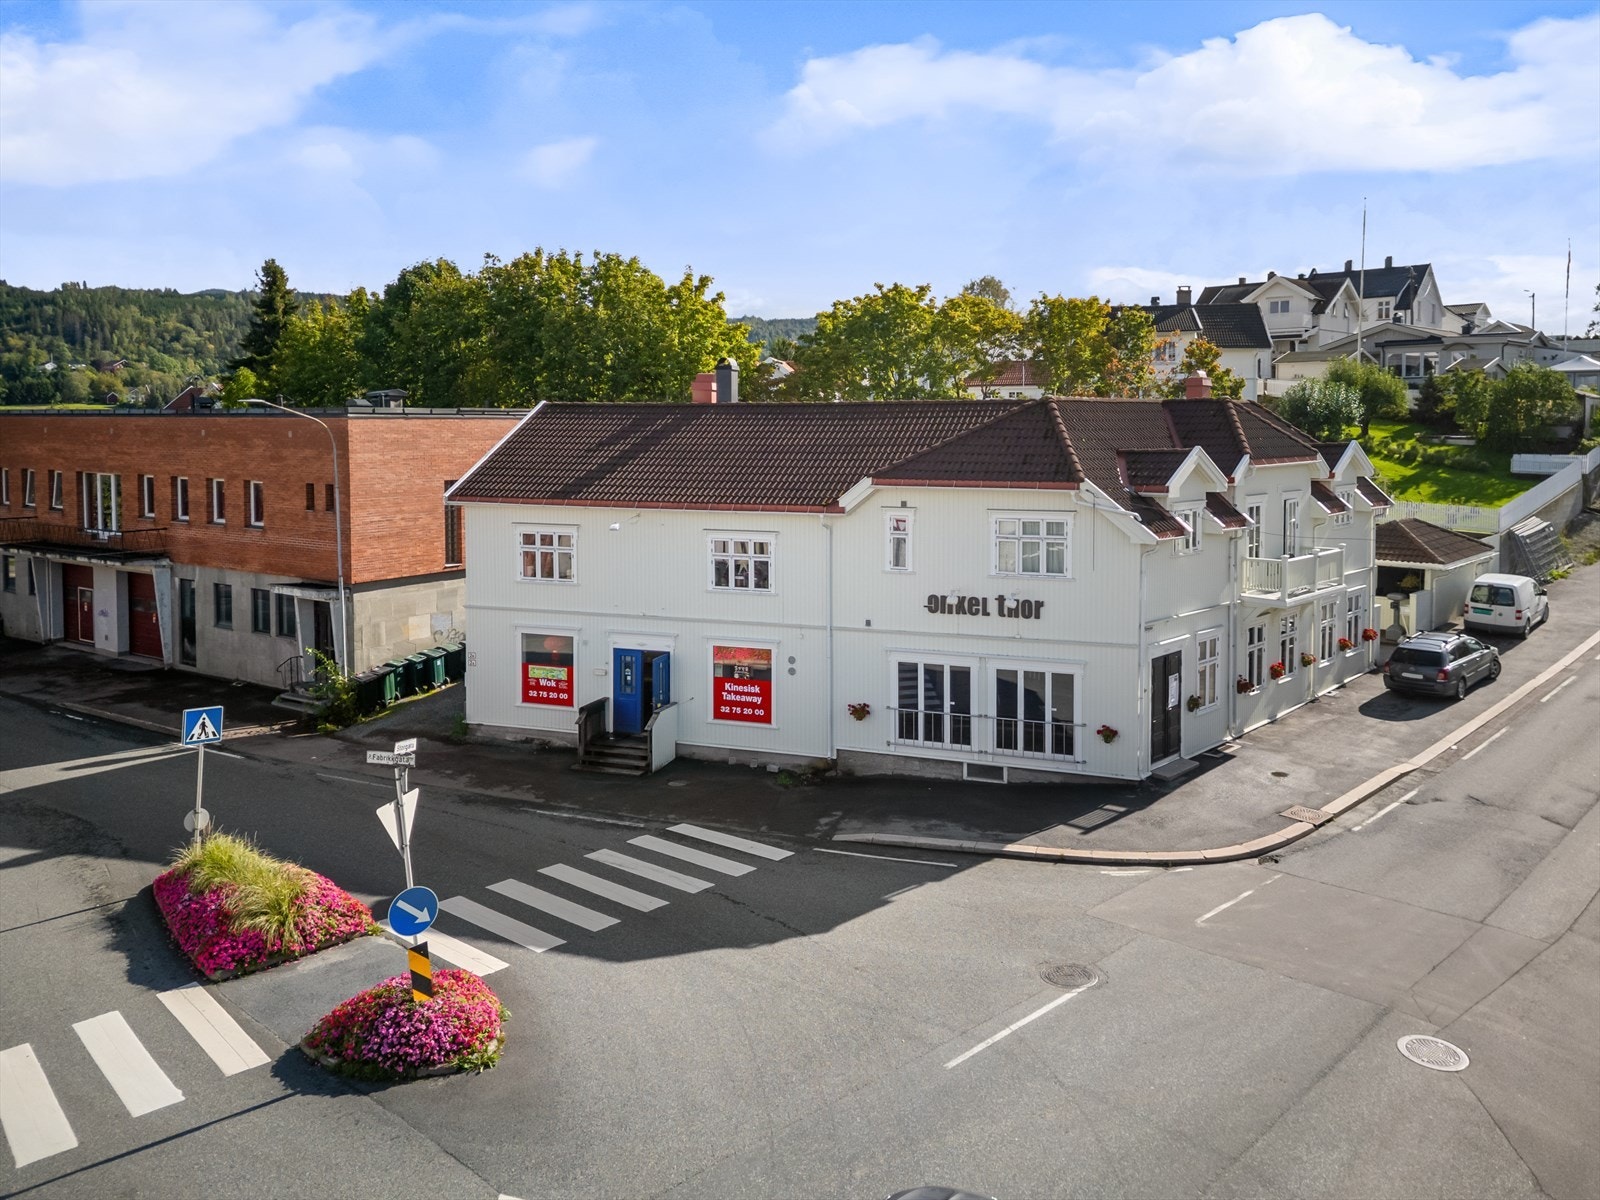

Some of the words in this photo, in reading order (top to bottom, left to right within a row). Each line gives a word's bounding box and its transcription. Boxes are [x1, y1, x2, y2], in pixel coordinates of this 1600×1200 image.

[539, 679, 556, 687] Wok
[724, 682, 760, 693] Kinesisk
[721, 691, 762, 705] Takeaway
